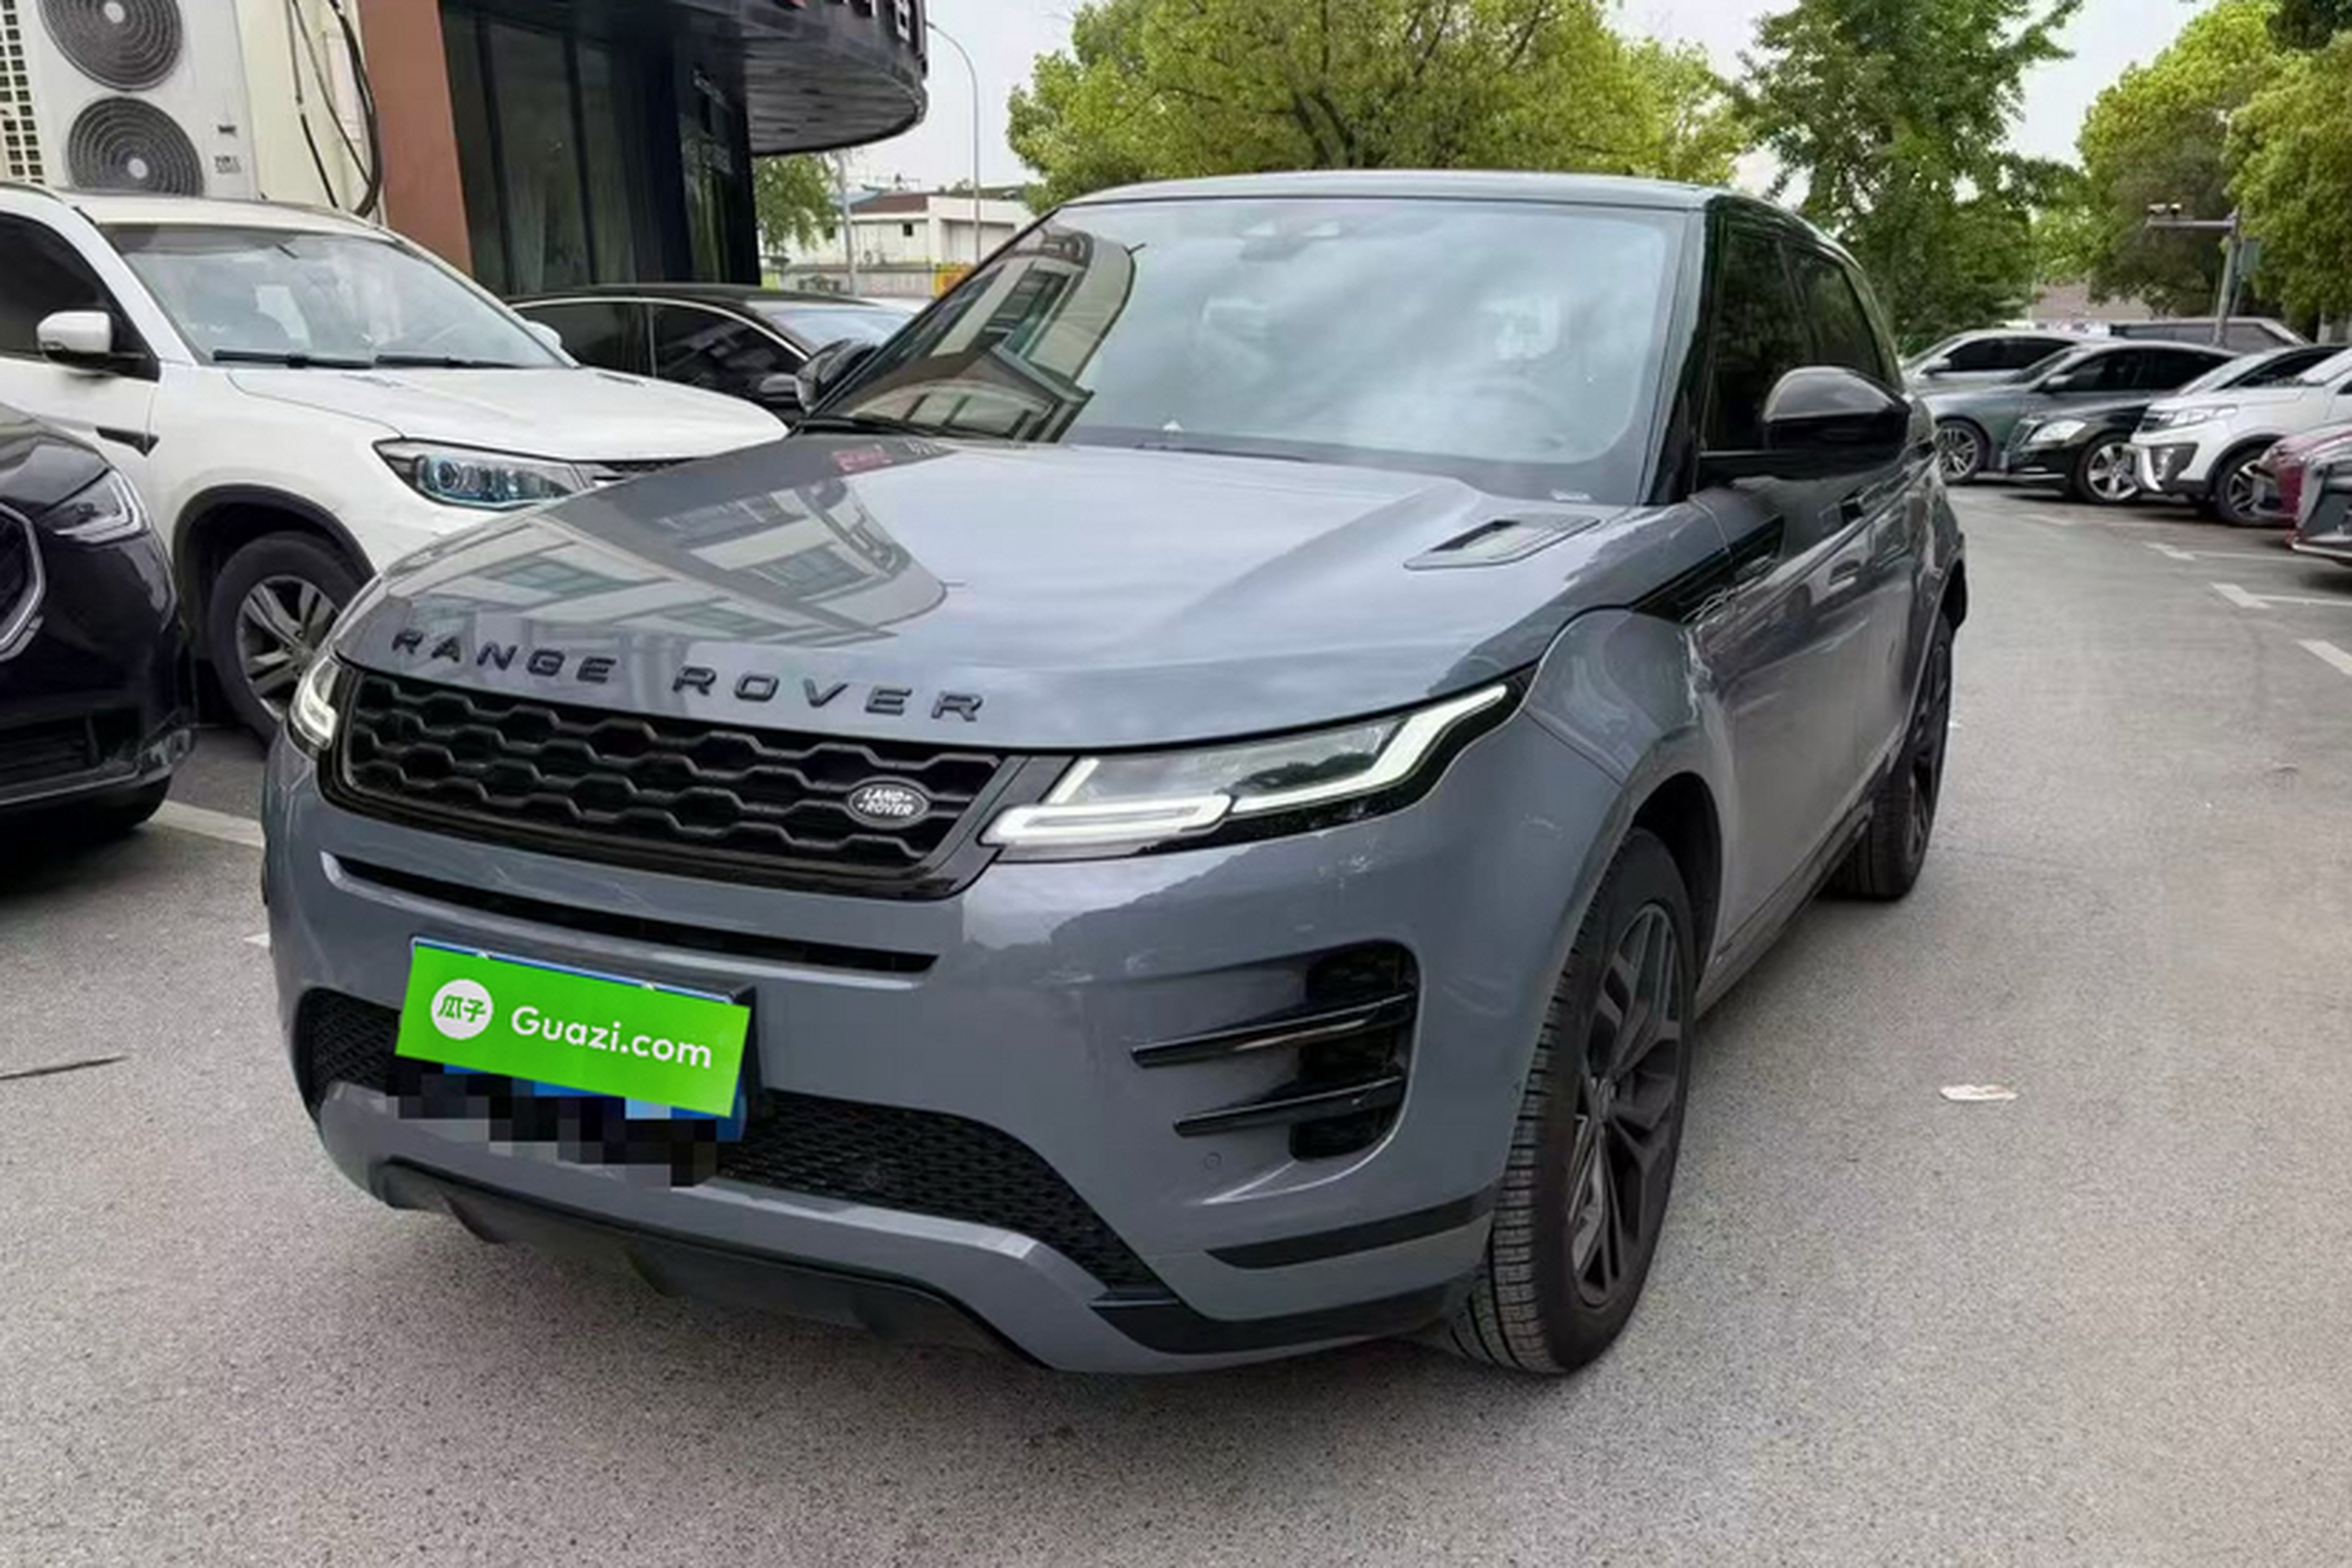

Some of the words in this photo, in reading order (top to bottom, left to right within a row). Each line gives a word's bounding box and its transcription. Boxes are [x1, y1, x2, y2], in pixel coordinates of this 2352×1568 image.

[392, 628, 616, 684] RANGE
[672, 665, 984, 723] ROVER
[864, 799, 914, 816] ROVER
